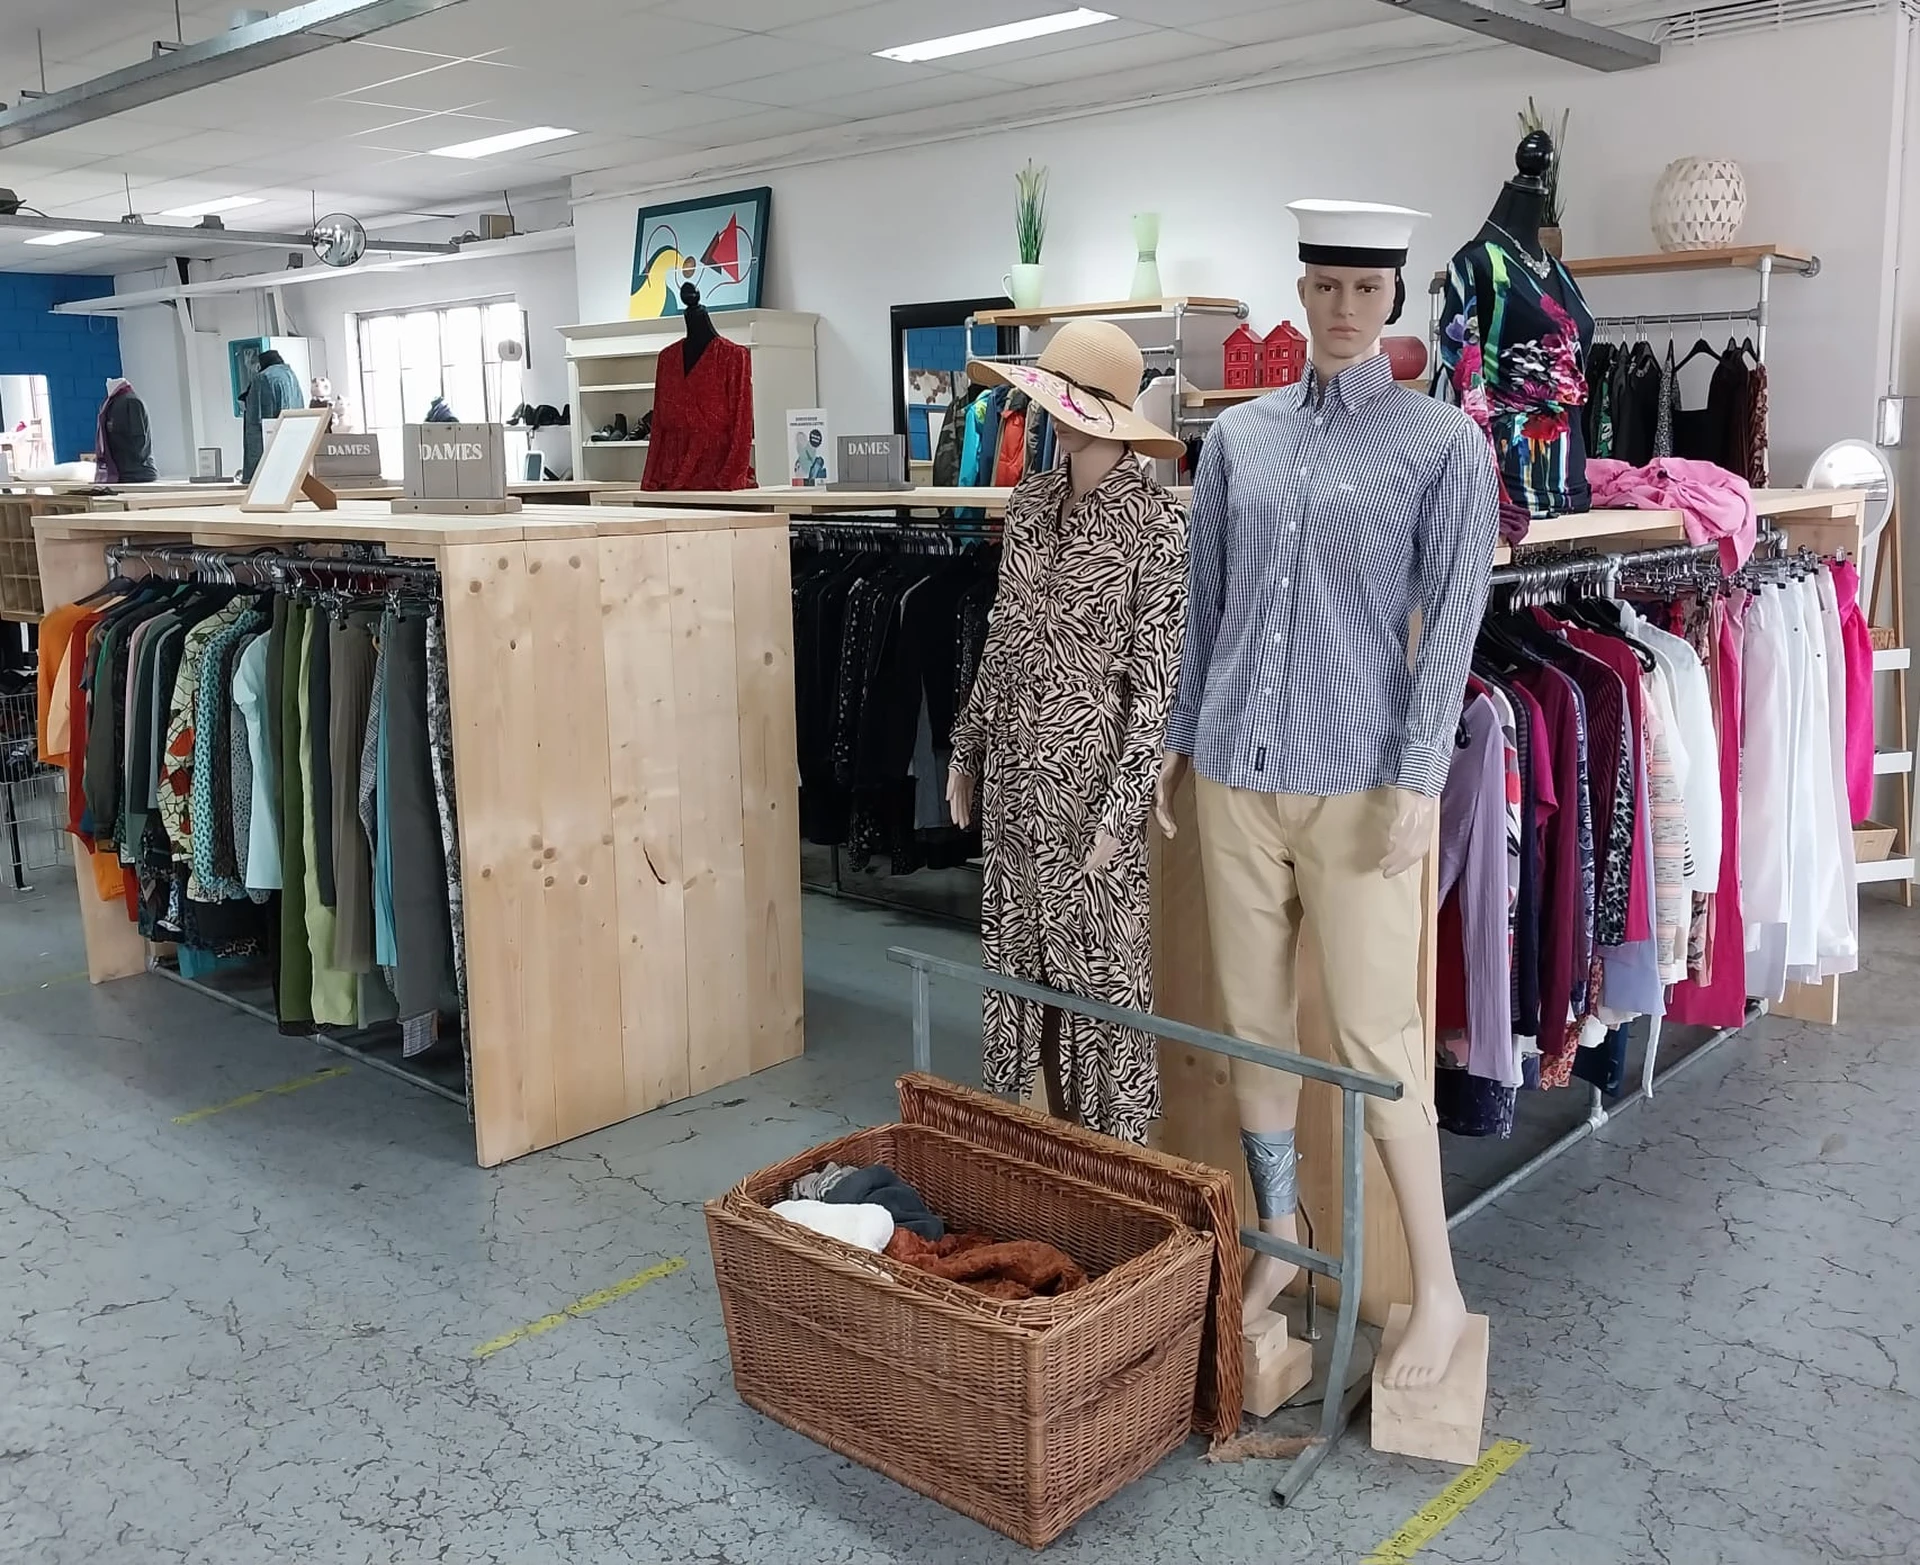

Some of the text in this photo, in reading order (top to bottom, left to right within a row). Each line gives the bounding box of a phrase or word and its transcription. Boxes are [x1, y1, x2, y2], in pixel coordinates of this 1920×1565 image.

[327, 444, 371, 456] DAMES
[418, 443, 483, 461] DAMES
[848, 442, 890, 456] DAMES
